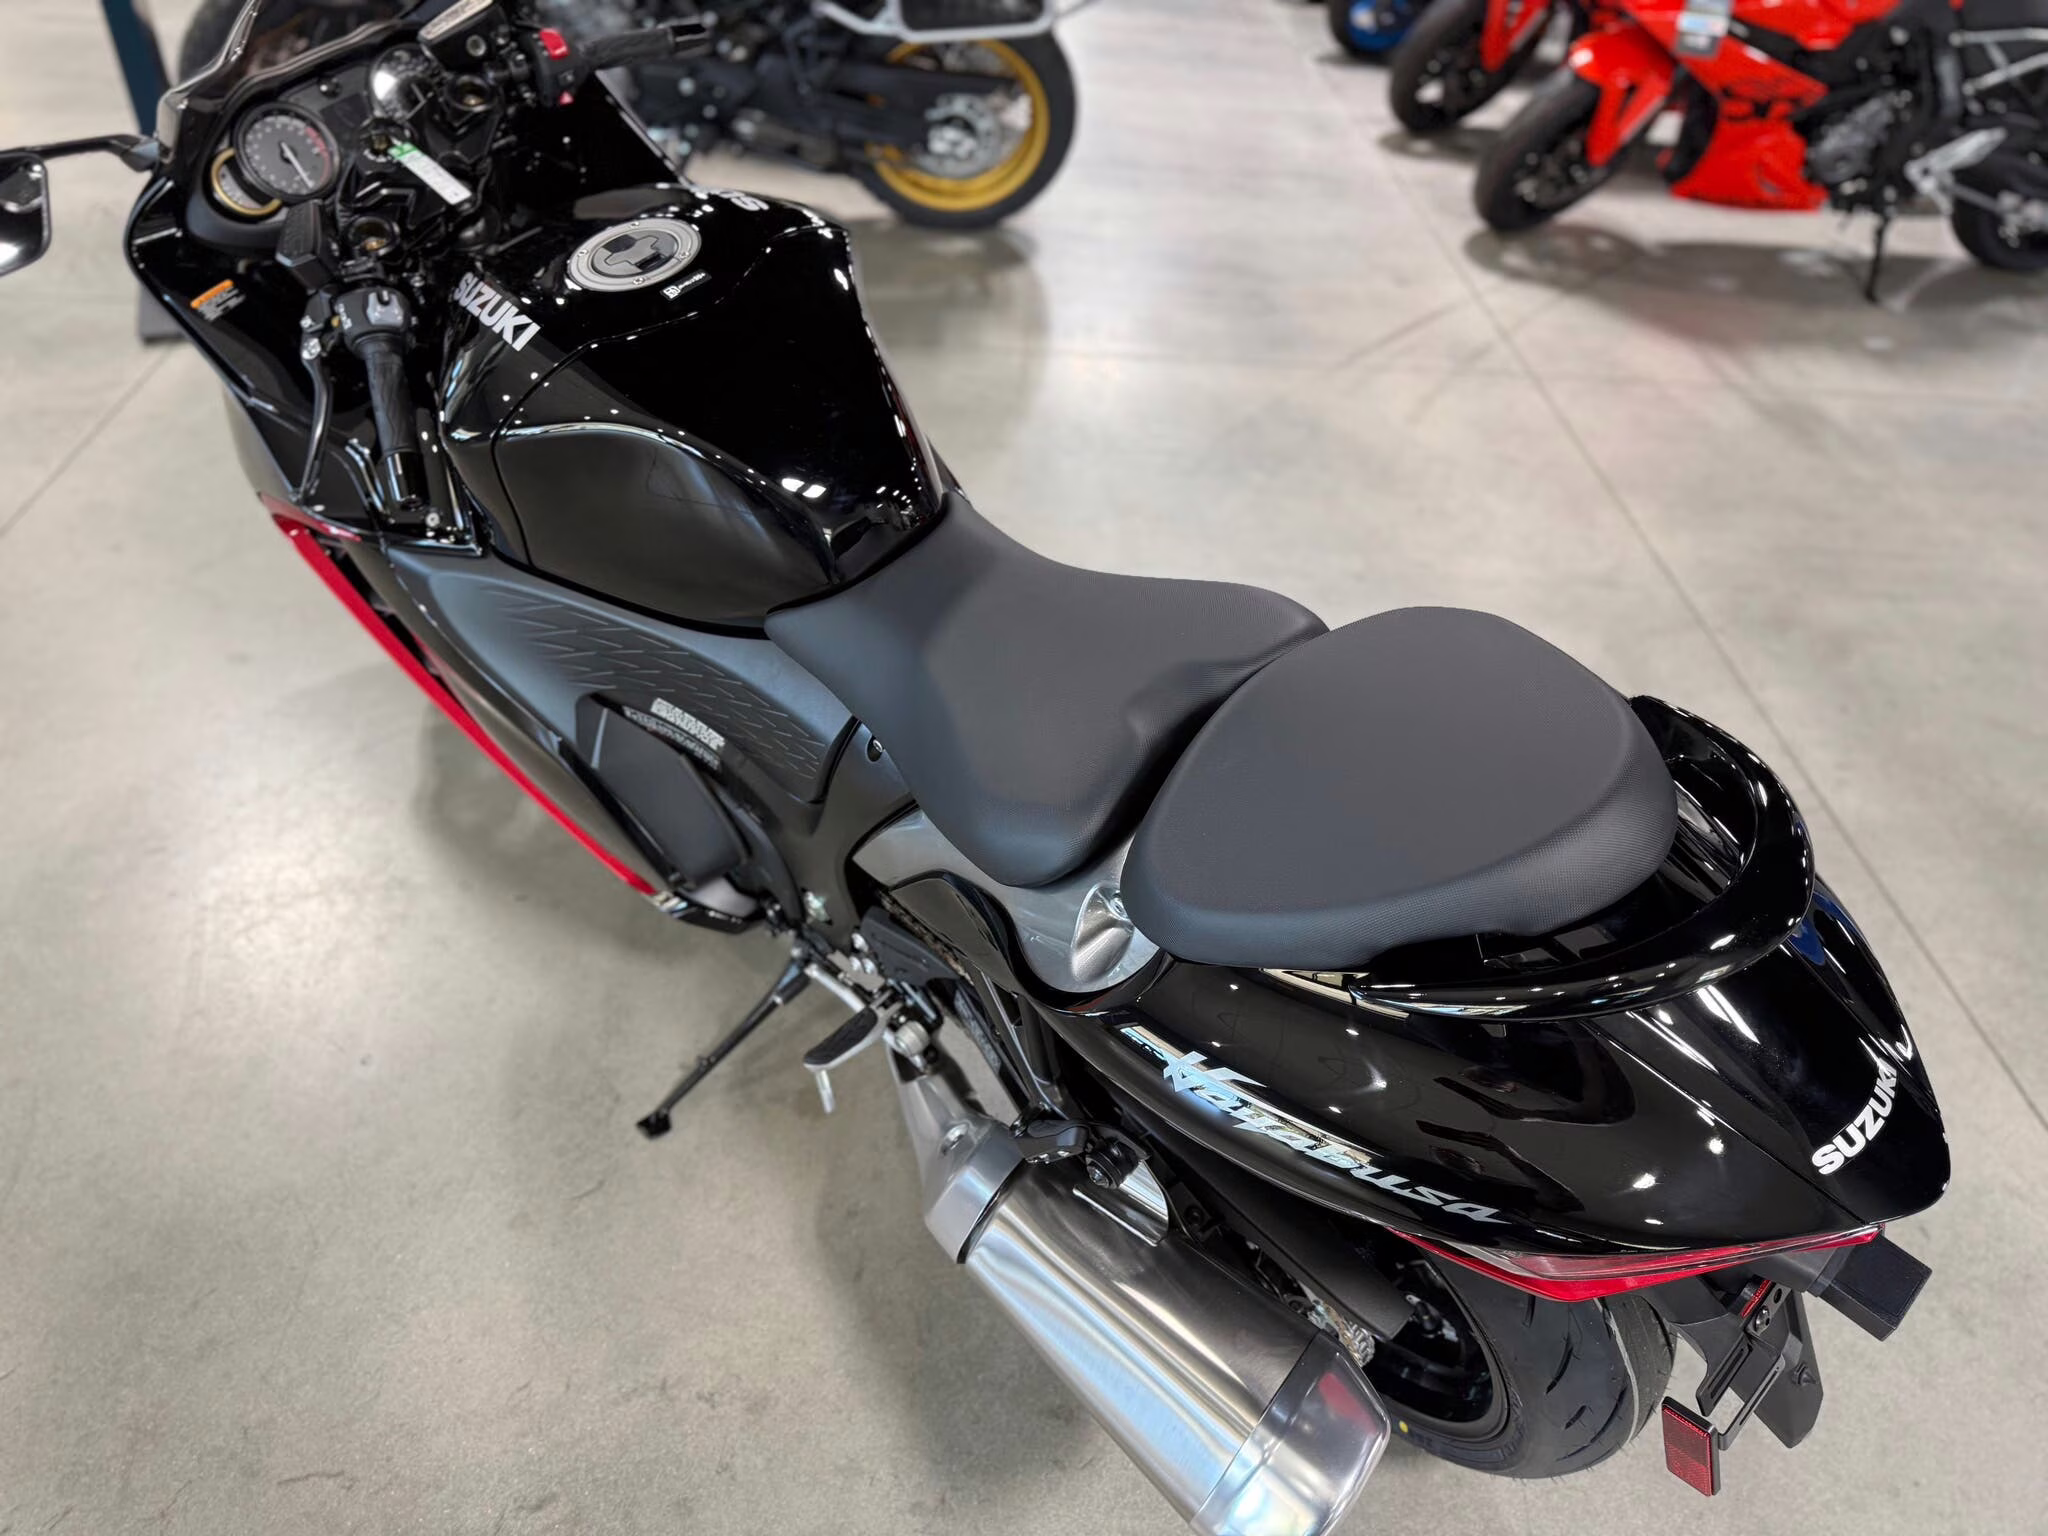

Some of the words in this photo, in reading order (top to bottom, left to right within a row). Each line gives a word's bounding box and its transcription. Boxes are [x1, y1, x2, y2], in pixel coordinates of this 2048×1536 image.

[453, 271, 542, 352] SUZUKI
[1163, 1051, 1511, 1224] Hayabusa
[1811, 1057, 1897, 1175] SUZUKI
